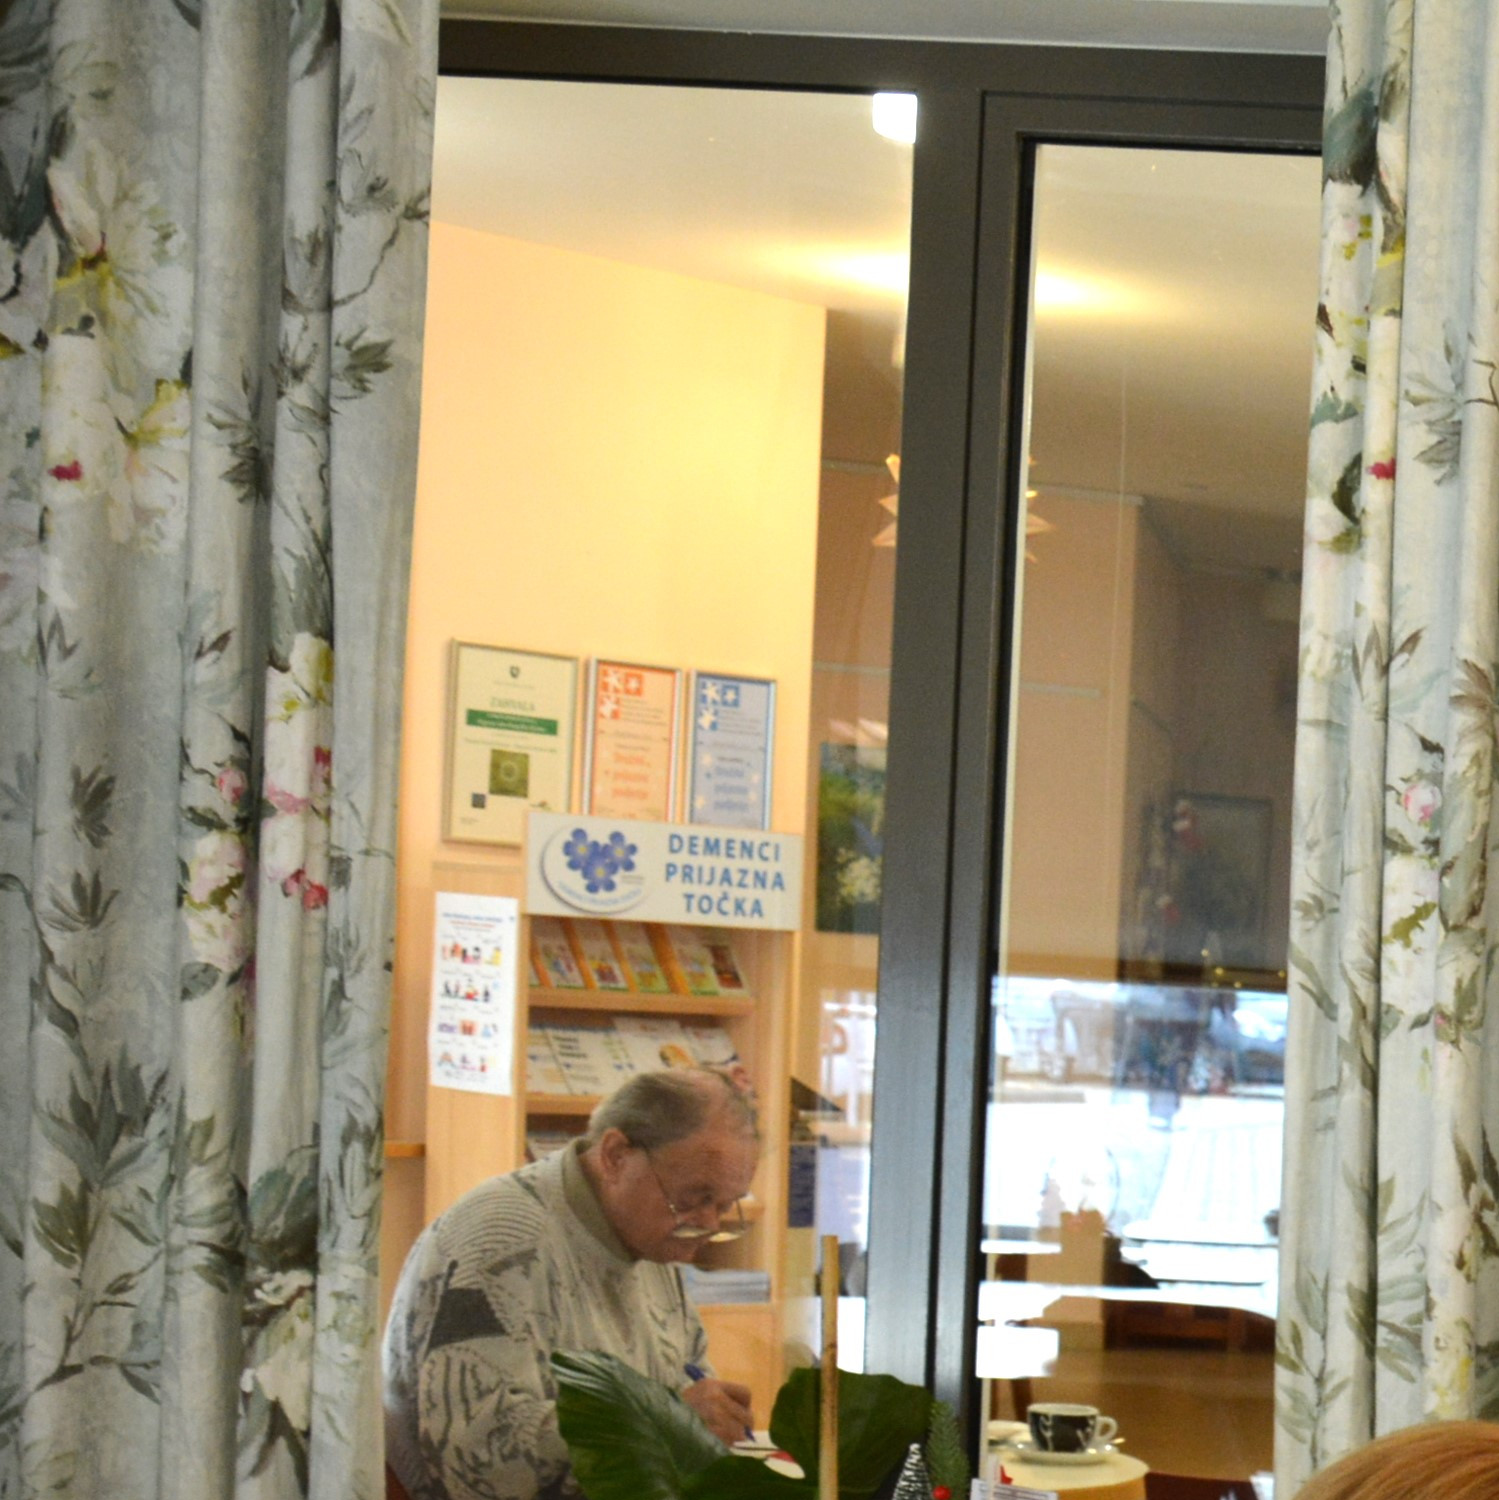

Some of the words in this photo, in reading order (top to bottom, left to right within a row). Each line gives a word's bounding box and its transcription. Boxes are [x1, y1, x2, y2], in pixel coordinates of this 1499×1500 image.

[668, 833, 781, 863] DEMENCI
[665, 863, 786, 891] PRIJAZNA
[683, 892, 765, 918] TOČKA
